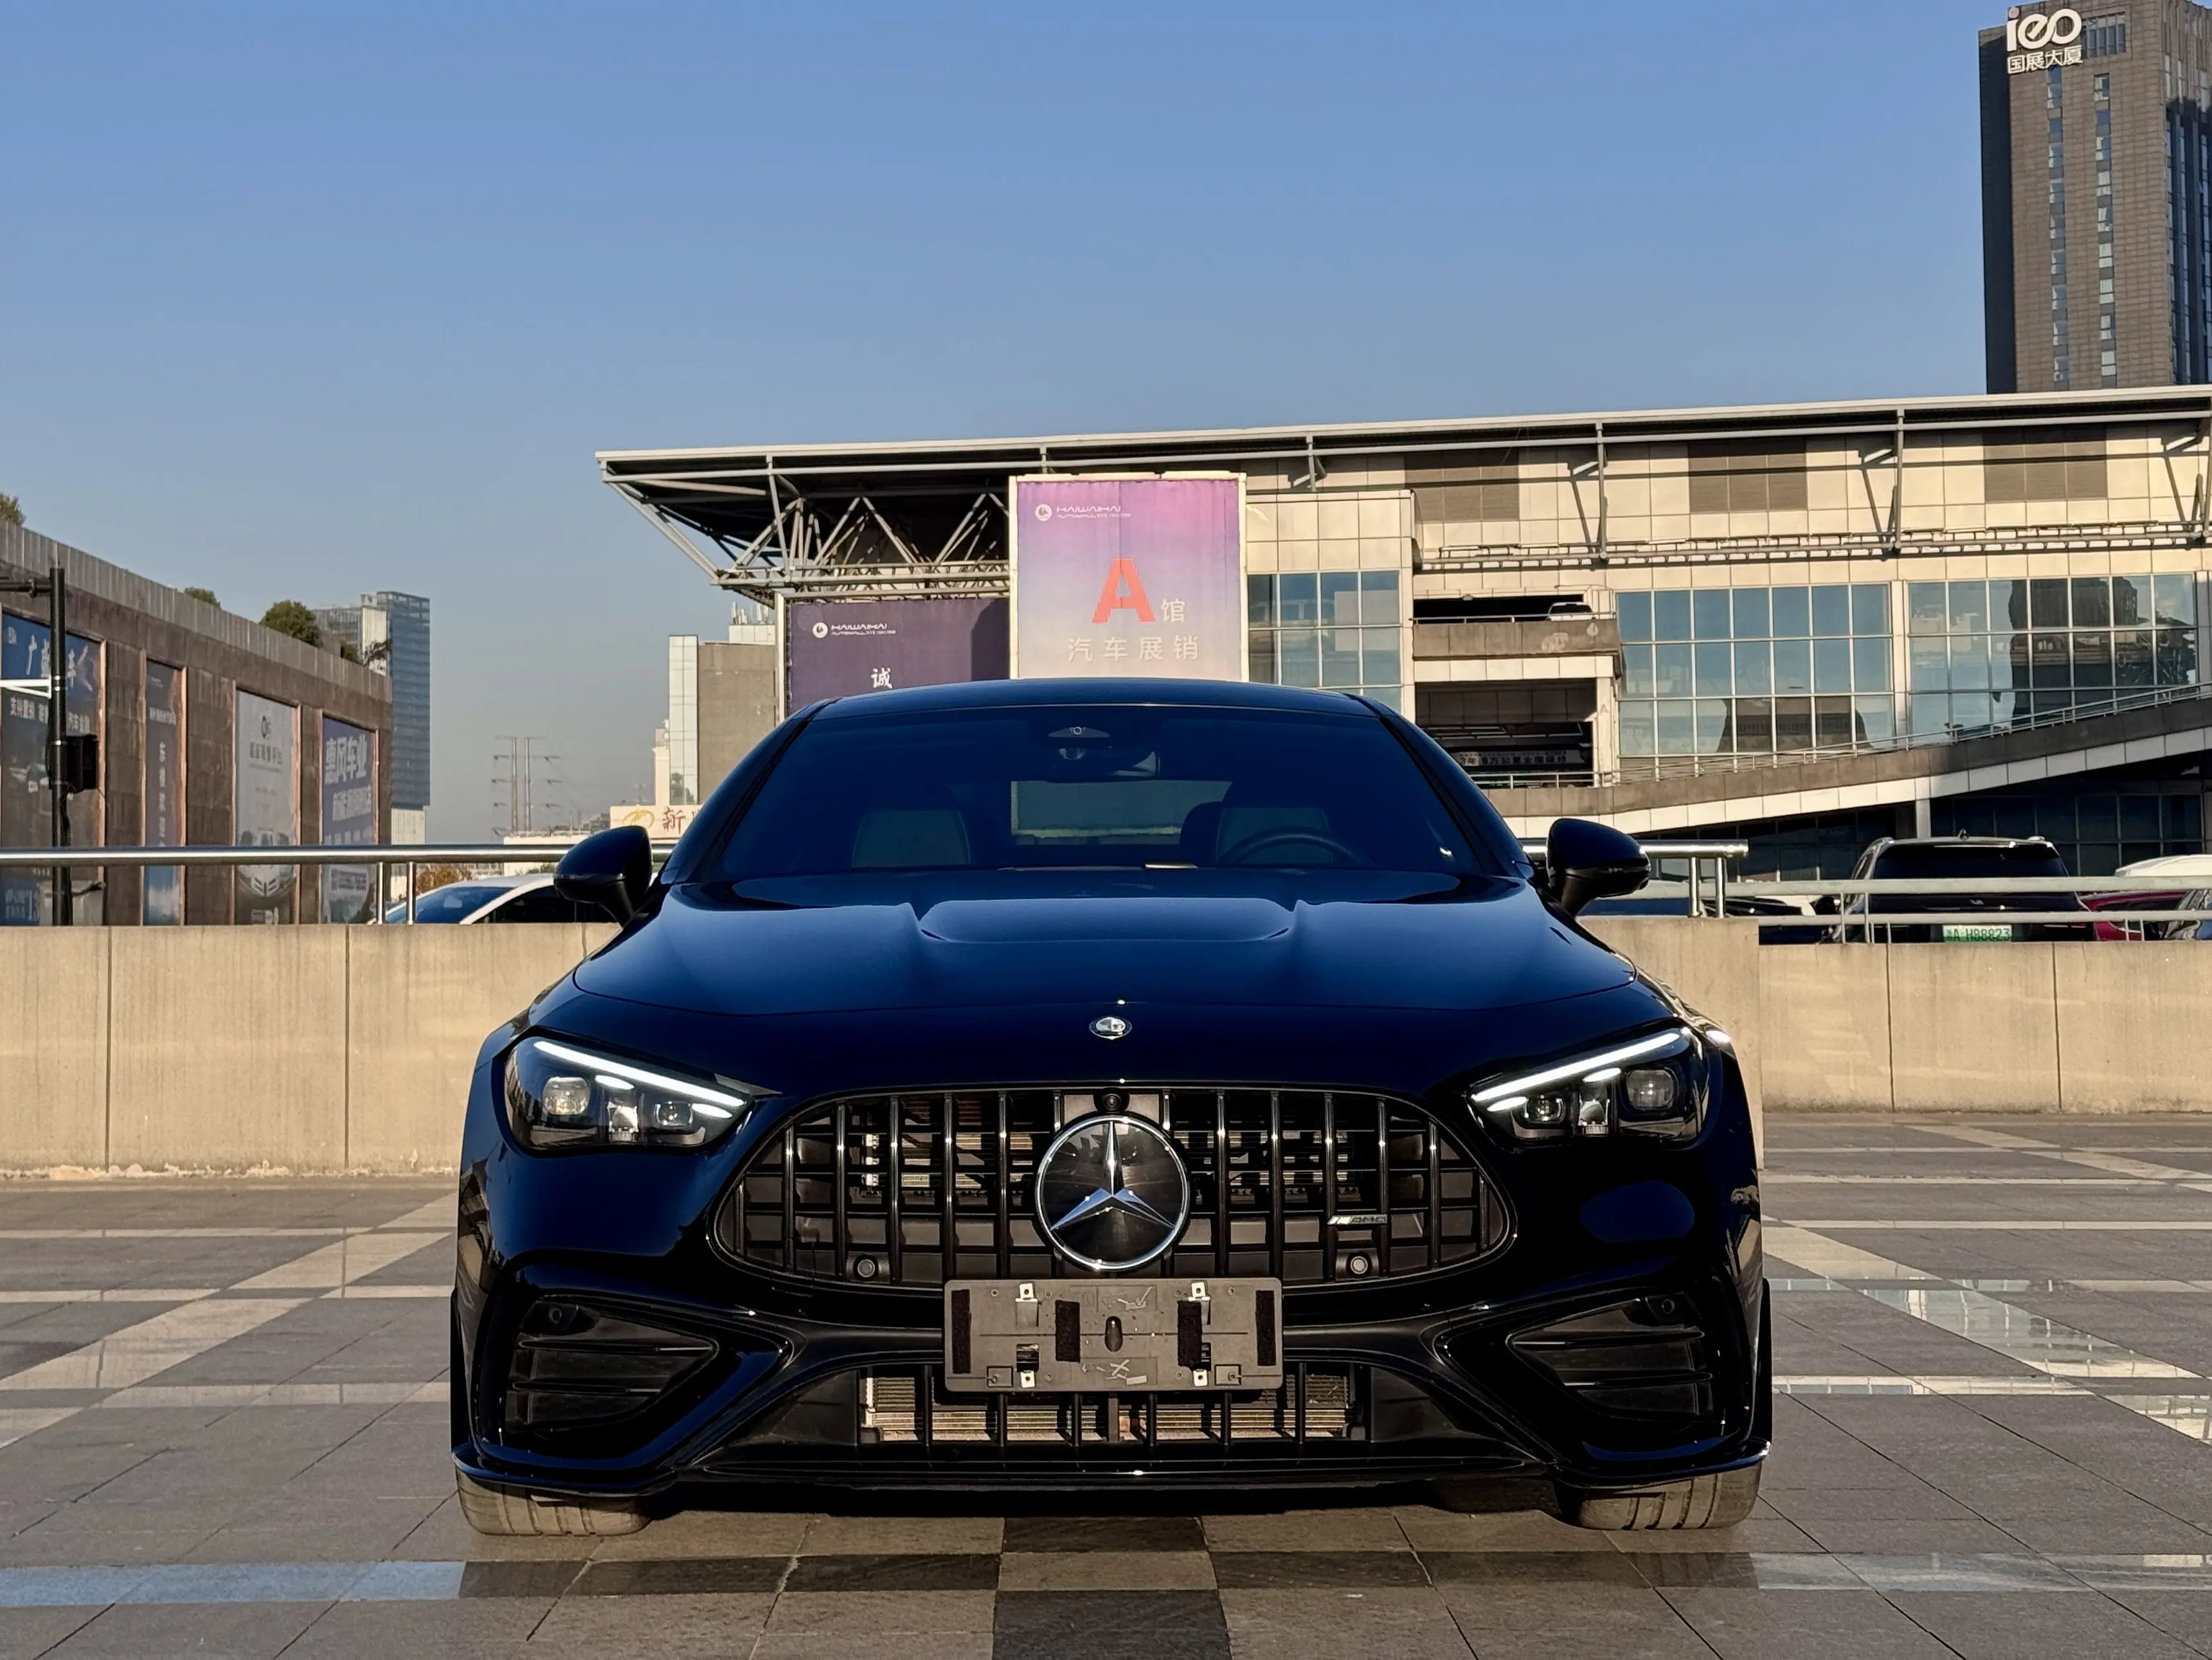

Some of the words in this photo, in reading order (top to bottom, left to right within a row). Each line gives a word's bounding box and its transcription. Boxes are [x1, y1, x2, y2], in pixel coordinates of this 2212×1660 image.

[2008, 45, 2083, 74] 国展大厦
[1067, 635, 1200, 663] 汽车展销
[870, 667, 892, 689] 诚
